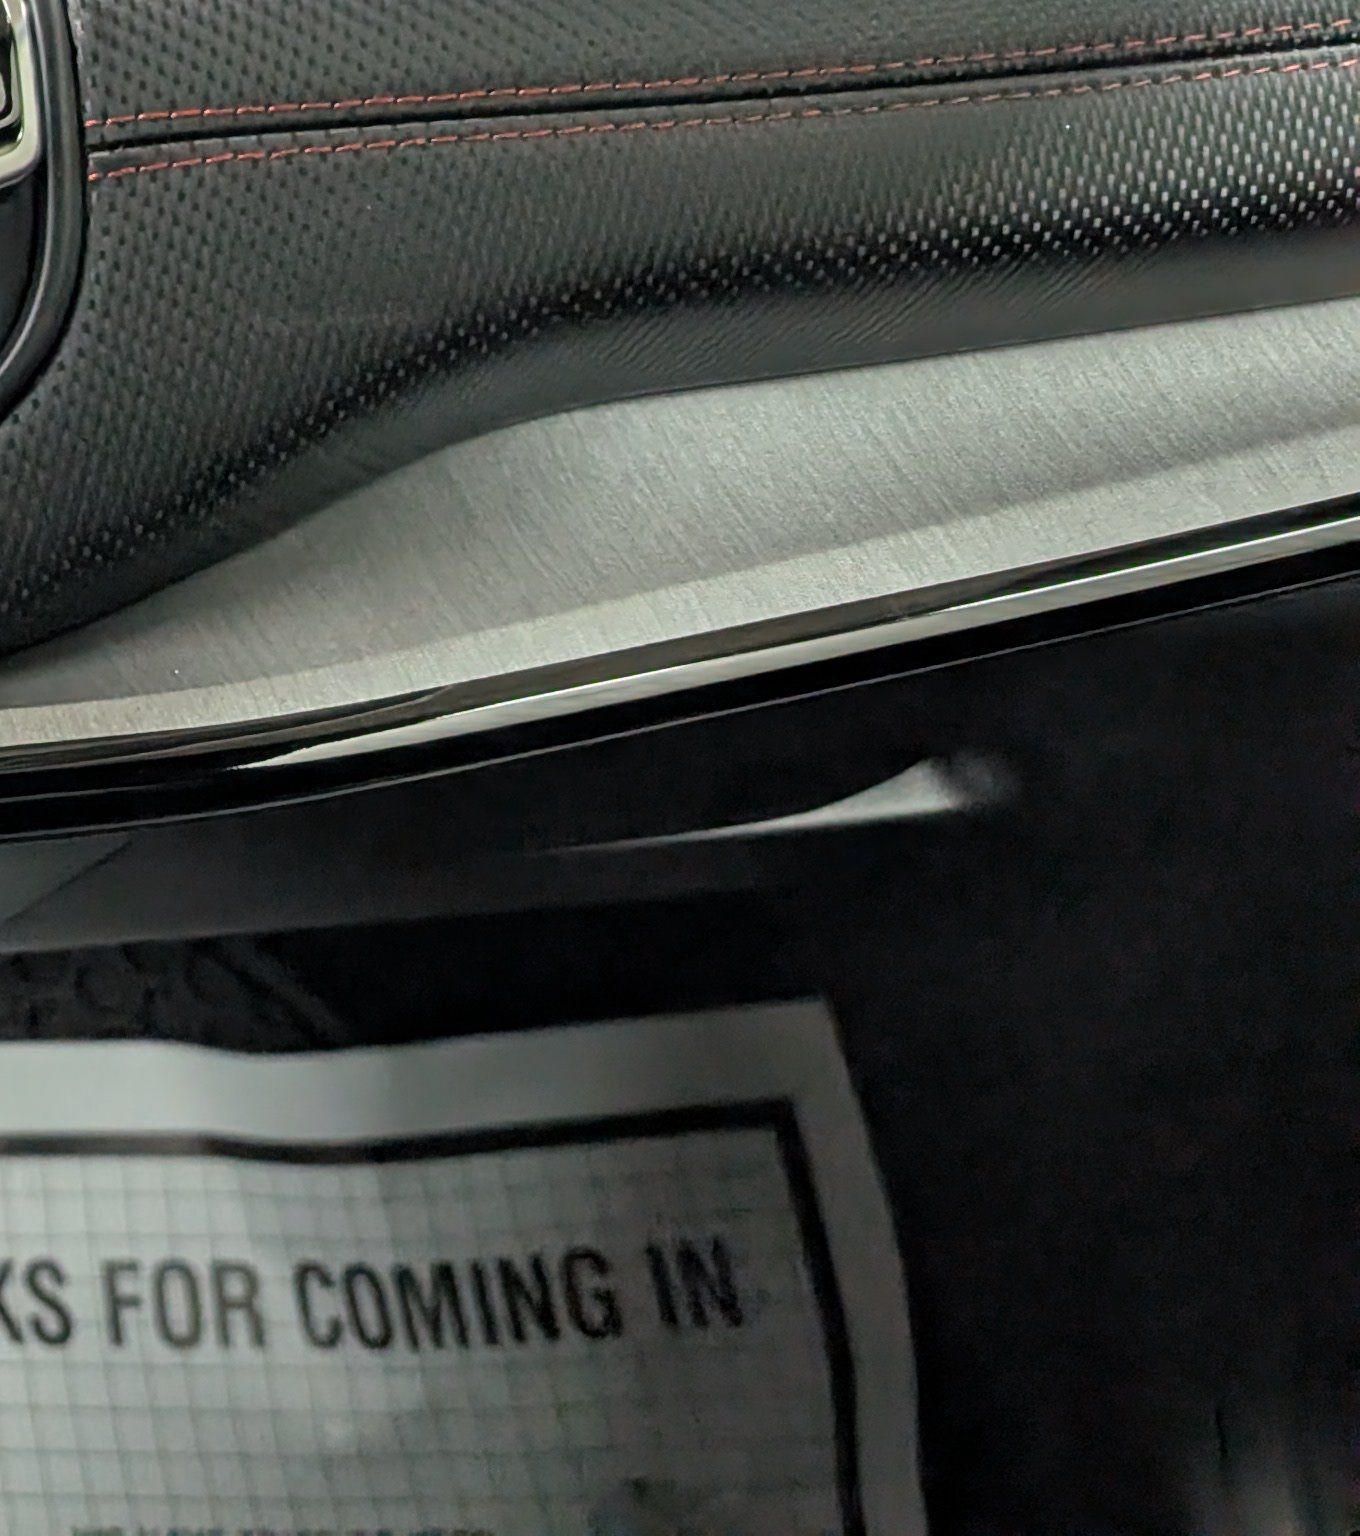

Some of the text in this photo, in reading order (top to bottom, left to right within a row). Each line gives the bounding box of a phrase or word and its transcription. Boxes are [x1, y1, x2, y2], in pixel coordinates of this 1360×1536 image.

[103, 1254, 266, 1354] FOR
[290, 1244, 621, 1354] COMING
[645, 1235, 745, 1333] IN
